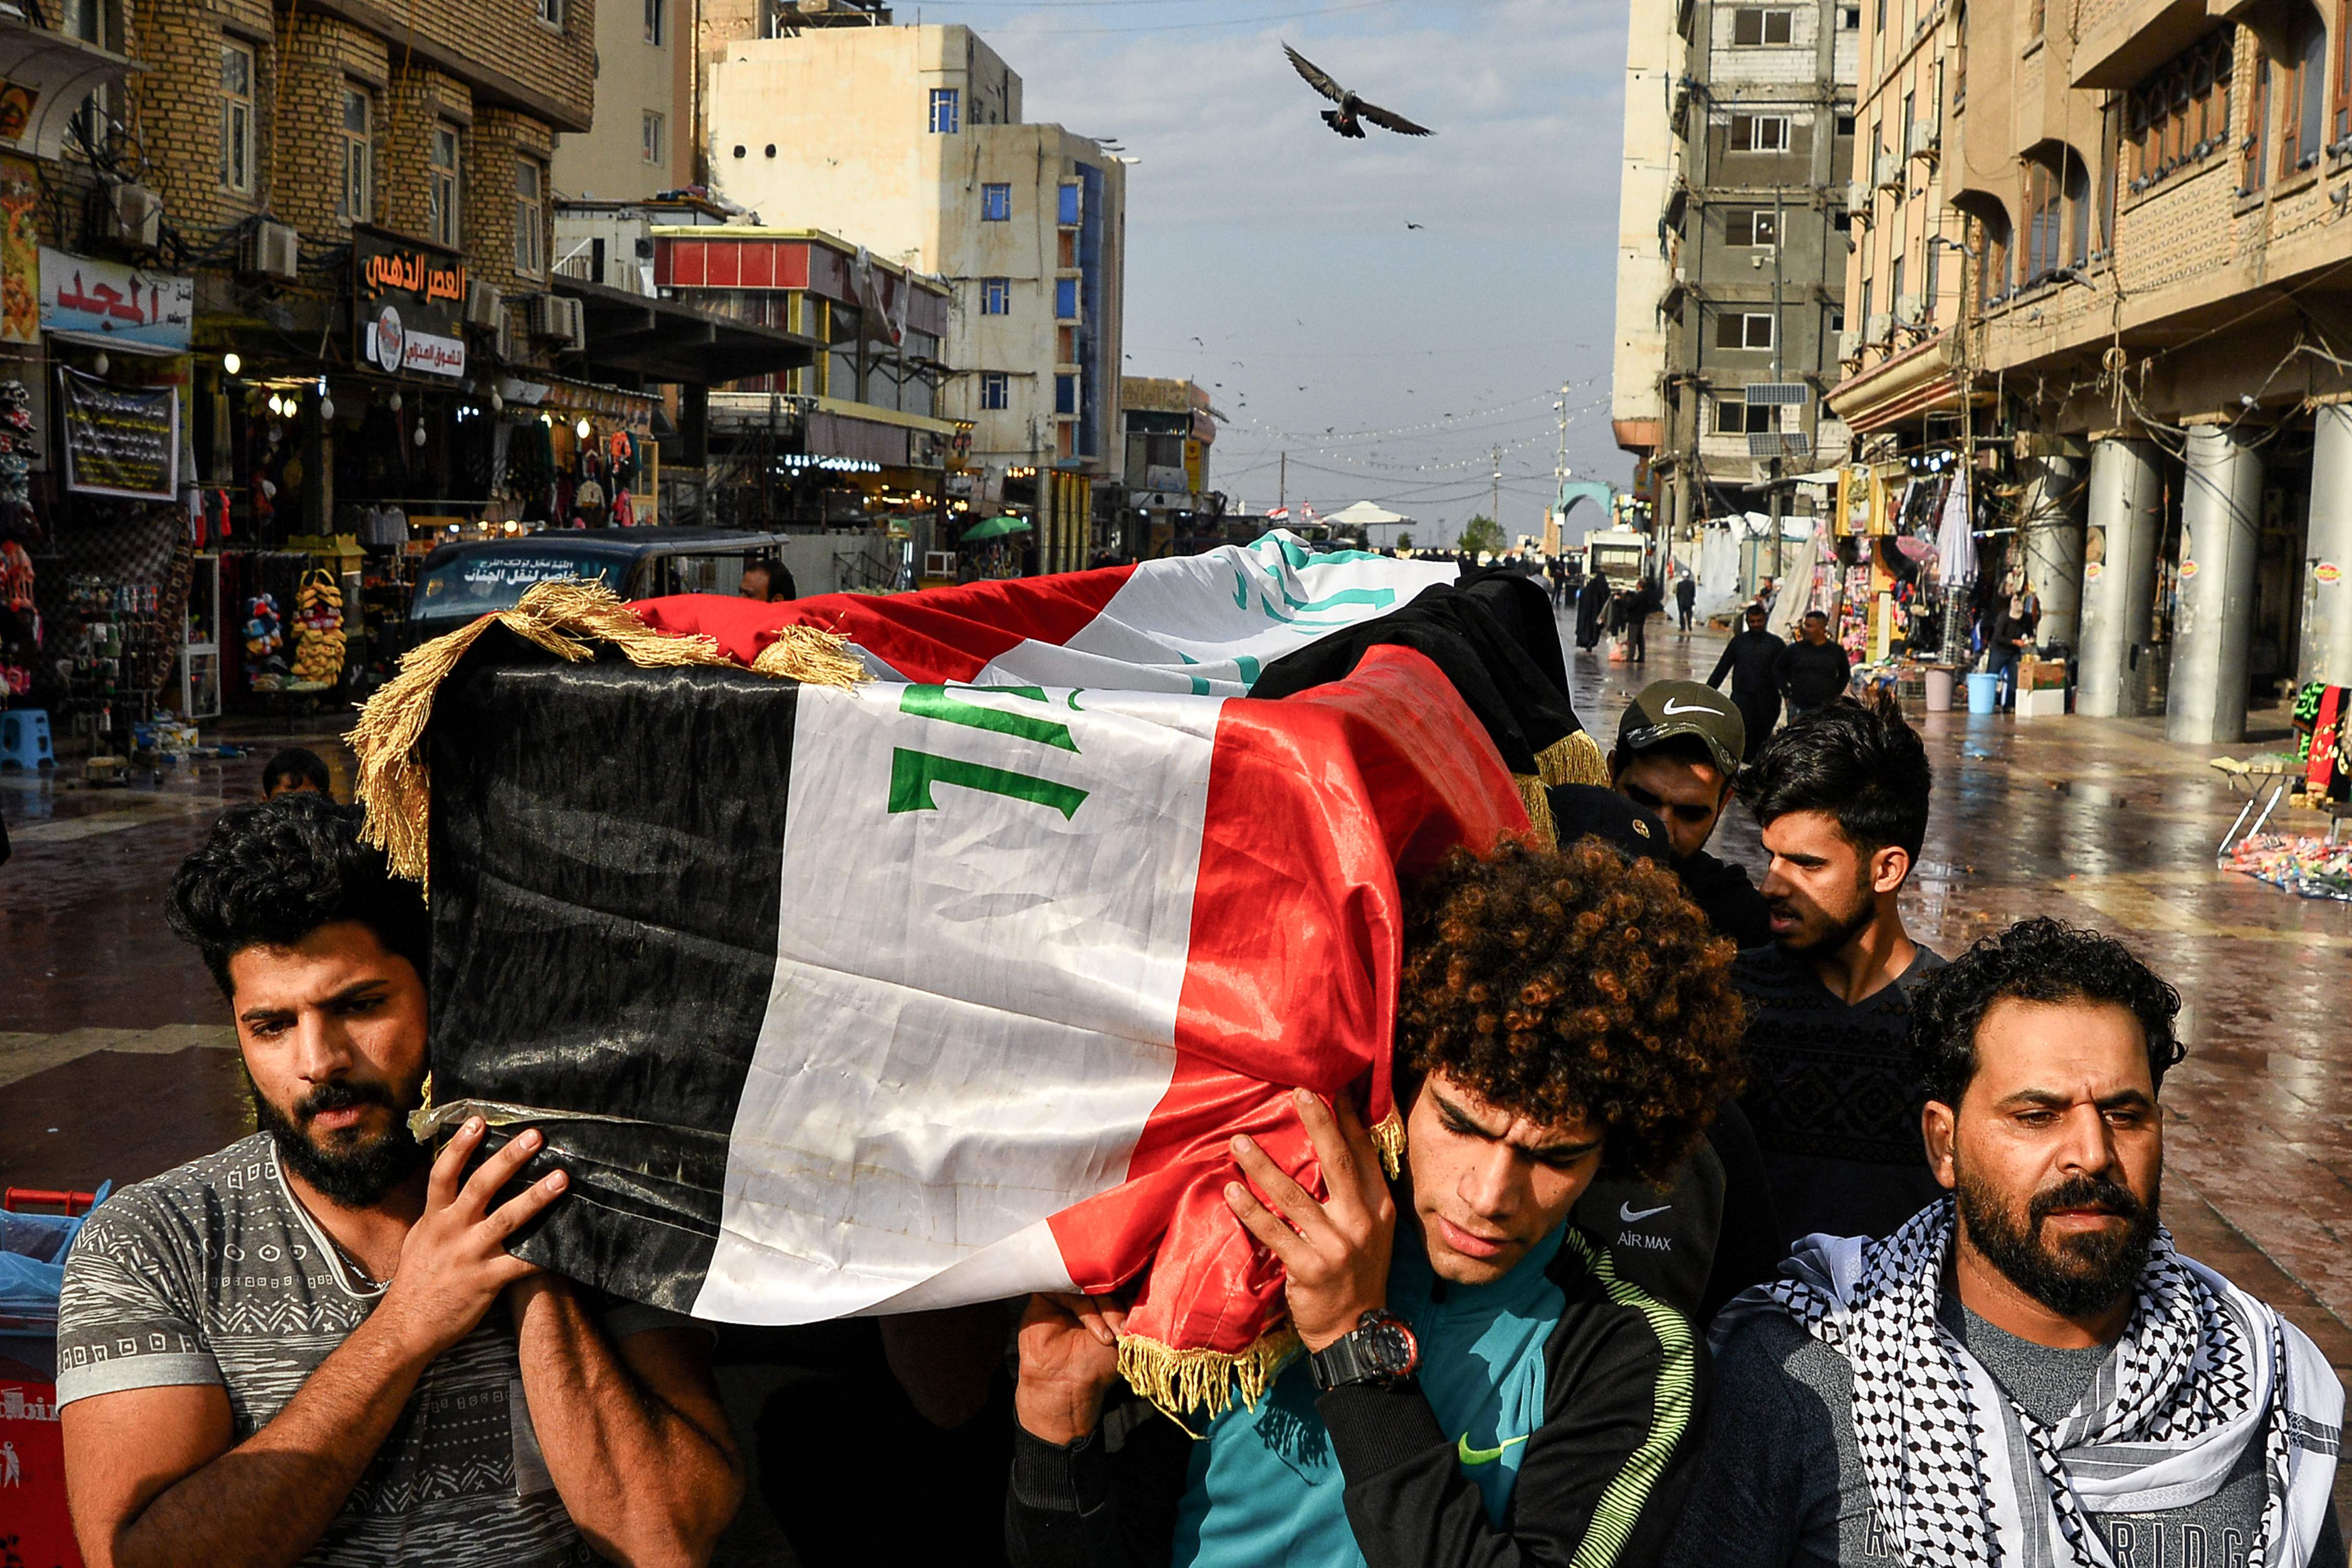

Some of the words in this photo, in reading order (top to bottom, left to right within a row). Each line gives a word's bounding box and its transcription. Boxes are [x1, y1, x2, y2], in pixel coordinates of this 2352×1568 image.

[366, 250, 425, 300] الذهبي
[426, 263, 467, 304] العصر
[58, 269, 158, 333] المجد
[506, 568, 539, 585] لنقل
[1645, 1234, 1672, 1251] MAX
[2110, 1520, 2248, 1568] RIDG
